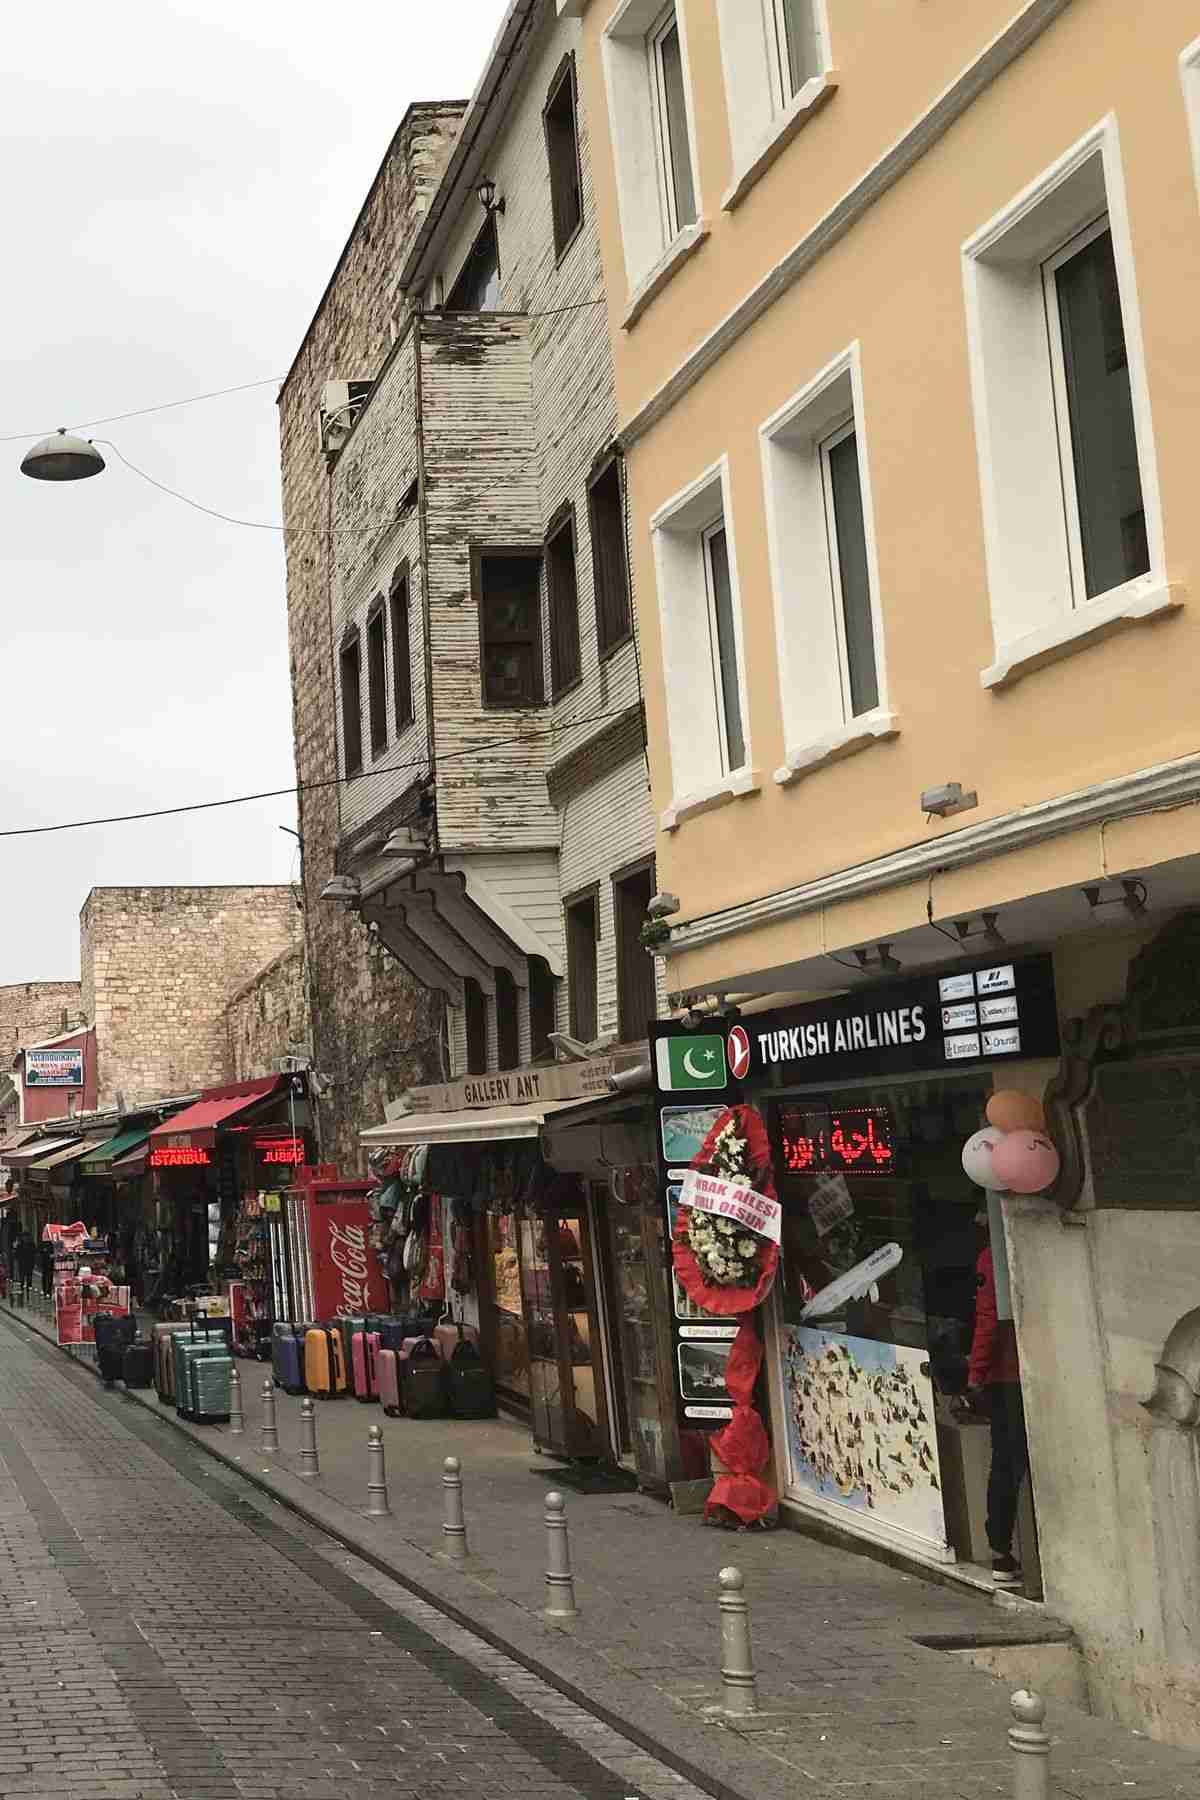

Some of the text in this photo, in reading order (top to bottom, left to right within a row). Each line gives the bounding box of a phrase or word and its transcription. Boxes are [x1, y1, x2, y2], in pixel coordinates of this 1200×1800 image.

[757, 1021, 831, 1065] TURKISH
[834, 1005, 927, 1053] AIRLINES
[464, 1075, 540, 1104] GALLERY ANT
[719, 1200, 767, 1232] OLSUN
